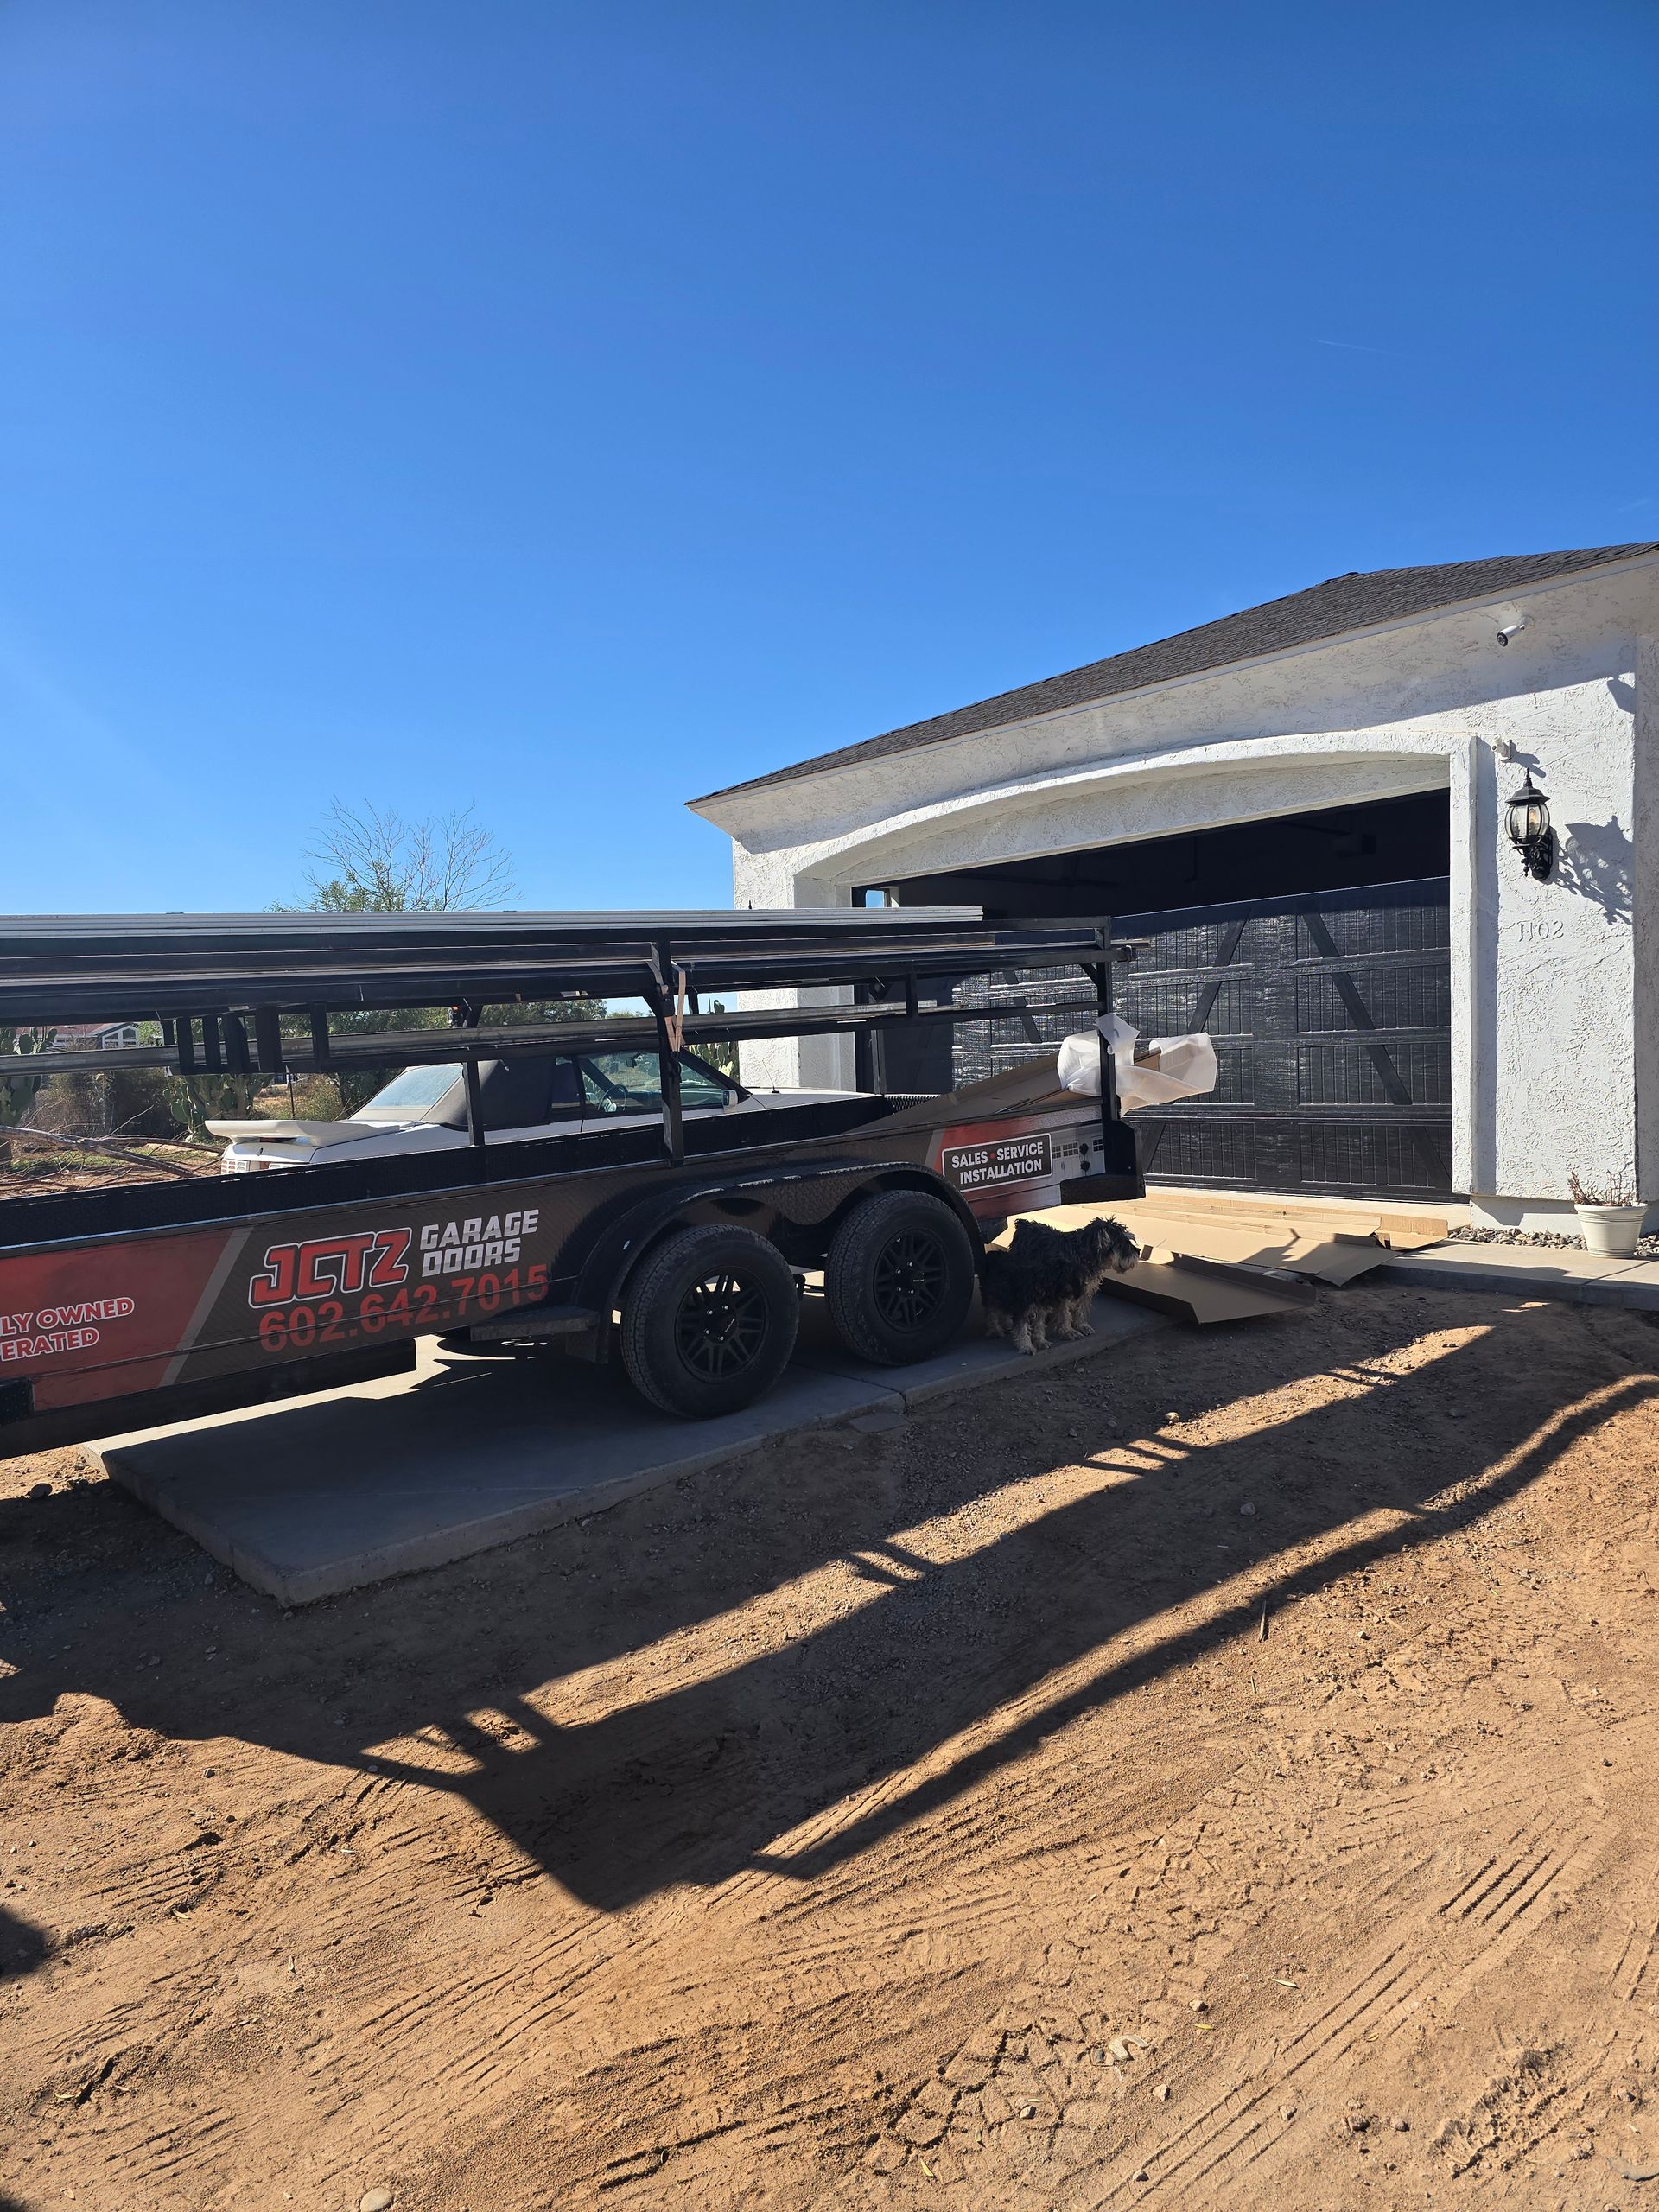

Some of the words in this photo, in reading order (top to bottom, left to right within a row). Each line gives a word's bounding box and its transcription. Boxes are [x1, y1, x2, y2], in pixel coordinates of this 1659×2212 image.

[951, 1151, 988, 1168] SALES
[996, 1141, 1044, 1161] SERVICE
[959, 1159, 1042, 1185] INSTALLATION
[420, 1209, 539, 1250] GARAGE
[422, 1237, 520, 1278] DOORS
[36, 1297, 135, 1329] OWNED
[259, 1264, 549, 1352] 602.642.7015
